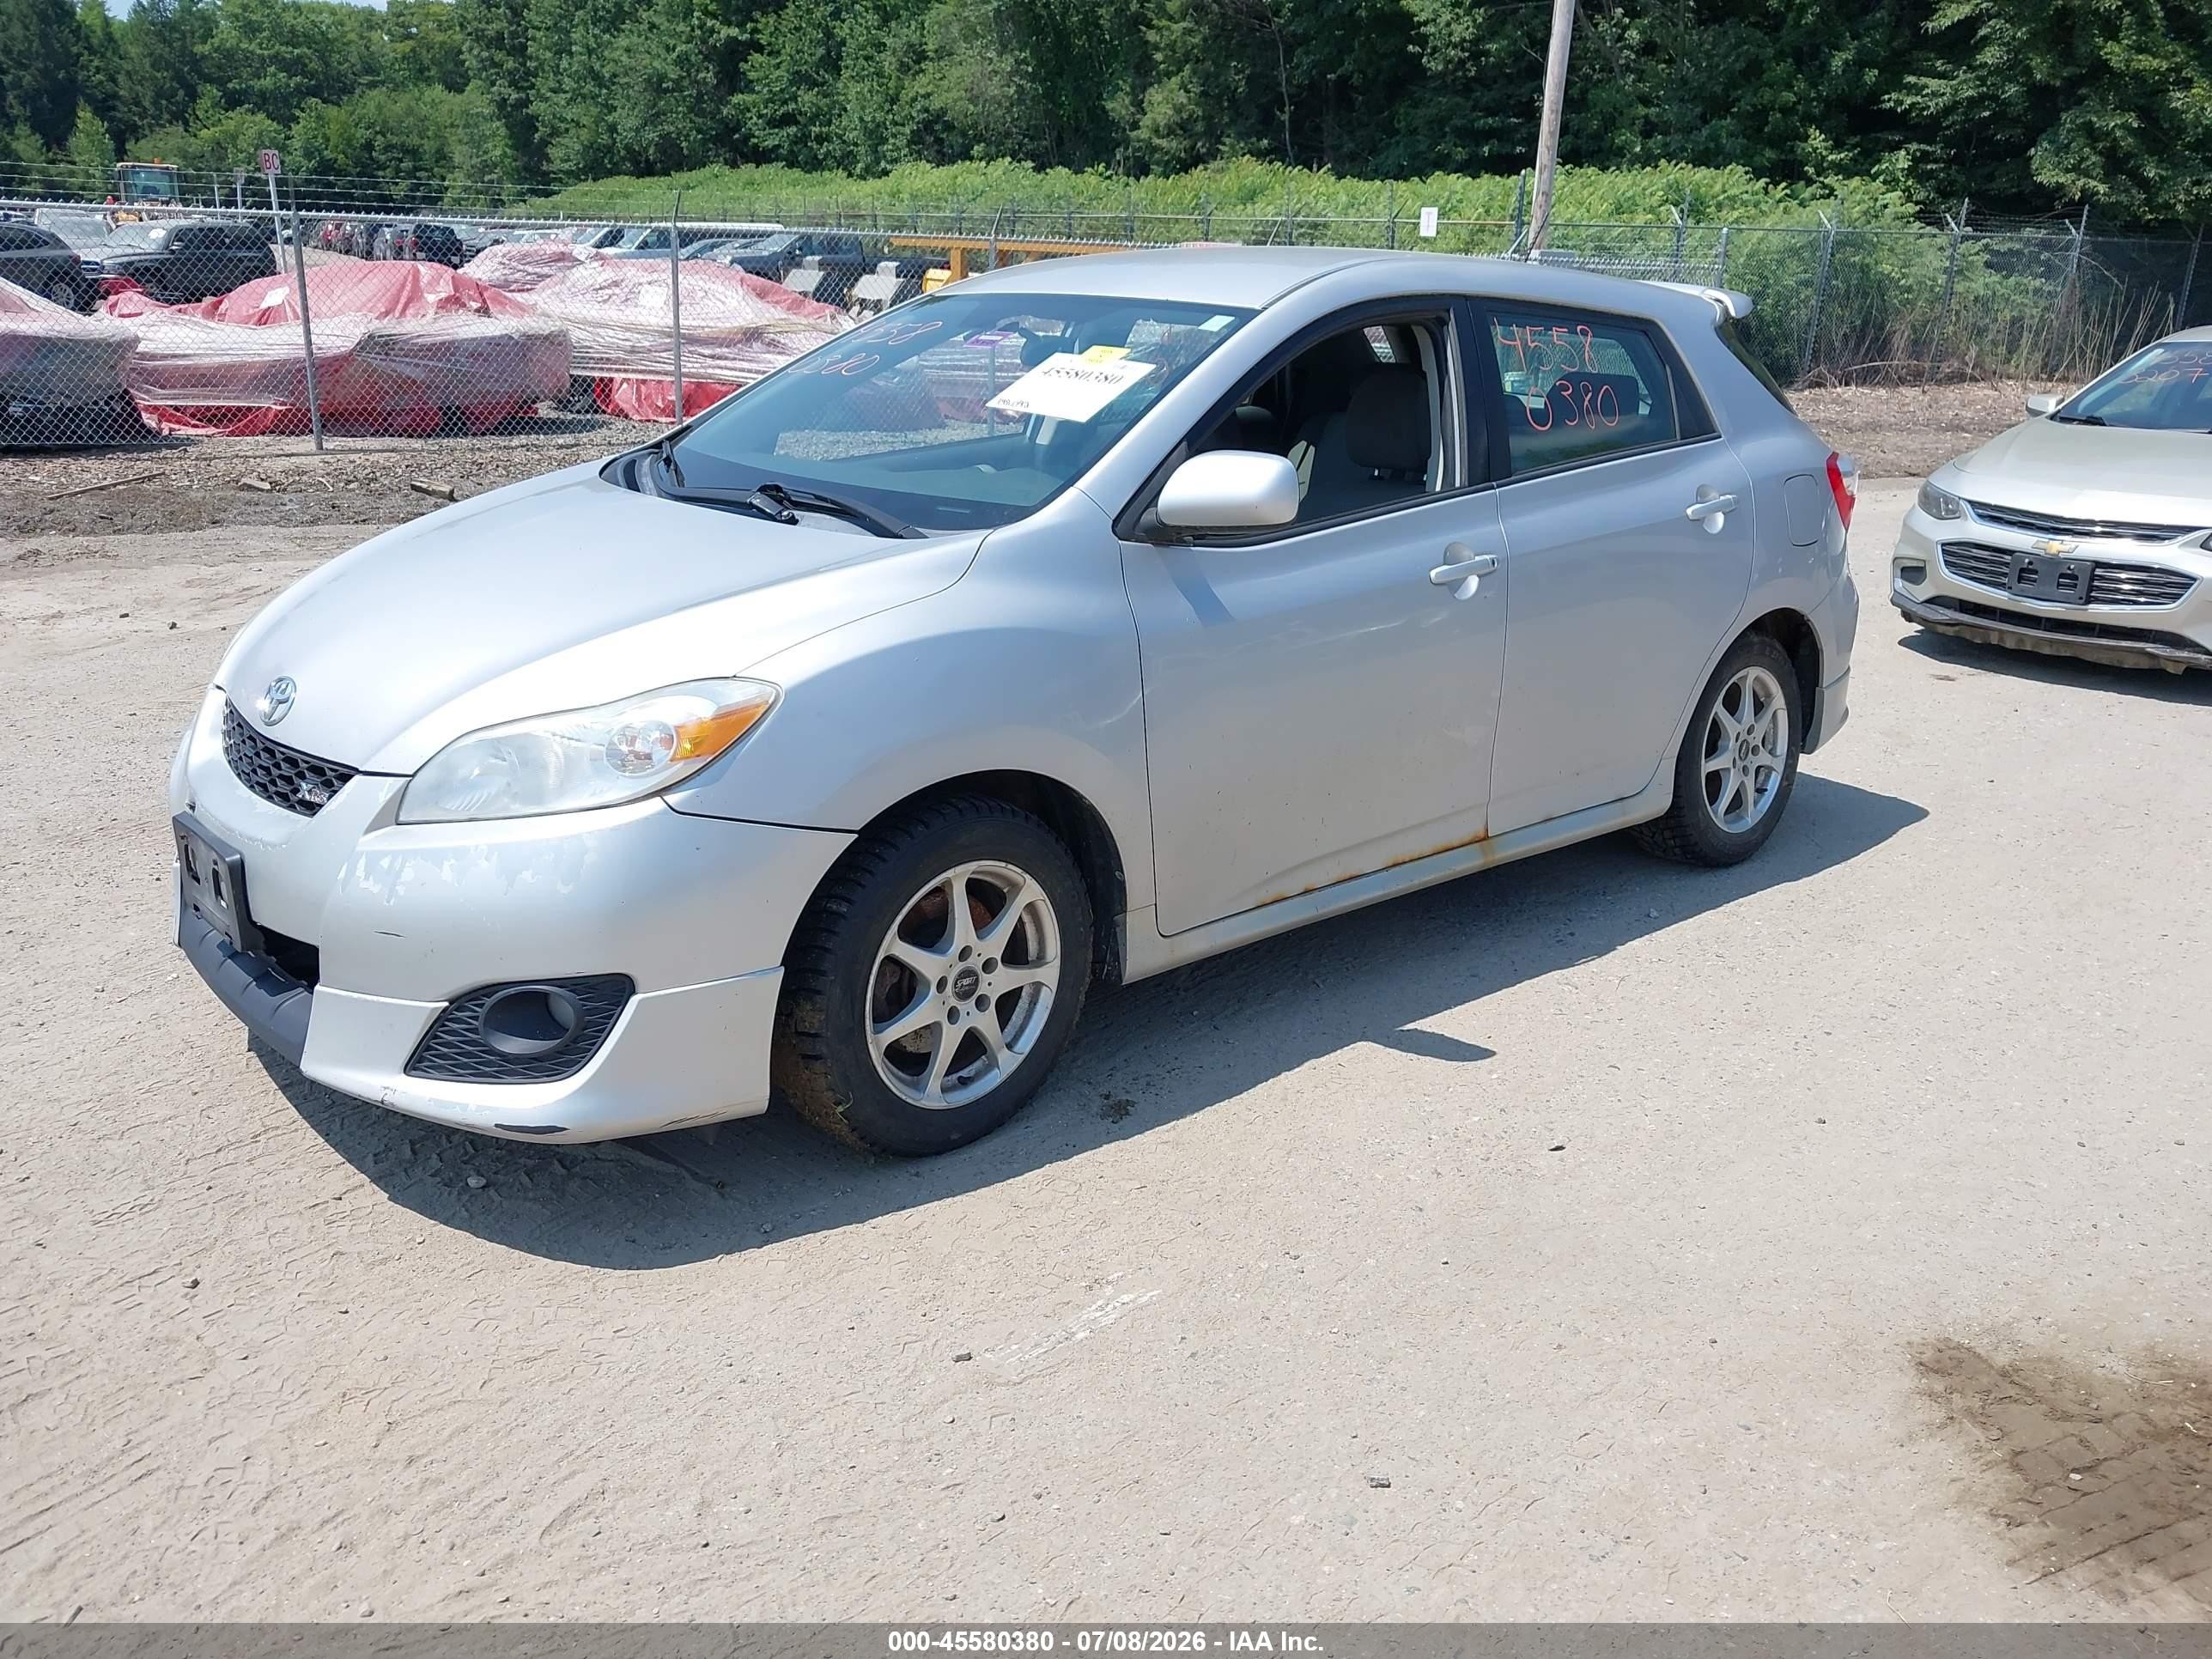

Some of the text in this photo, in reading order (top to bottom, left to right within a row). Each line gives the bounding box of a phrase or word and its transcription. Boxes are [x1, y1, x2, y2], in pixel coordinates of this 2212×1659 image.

[264, 153, 280, 170] BC
[1493, 317, 1598, 373] 4558
[1041, 366, 1125, 385] 45580380
[1526, 381, 1620, 431] 0380
